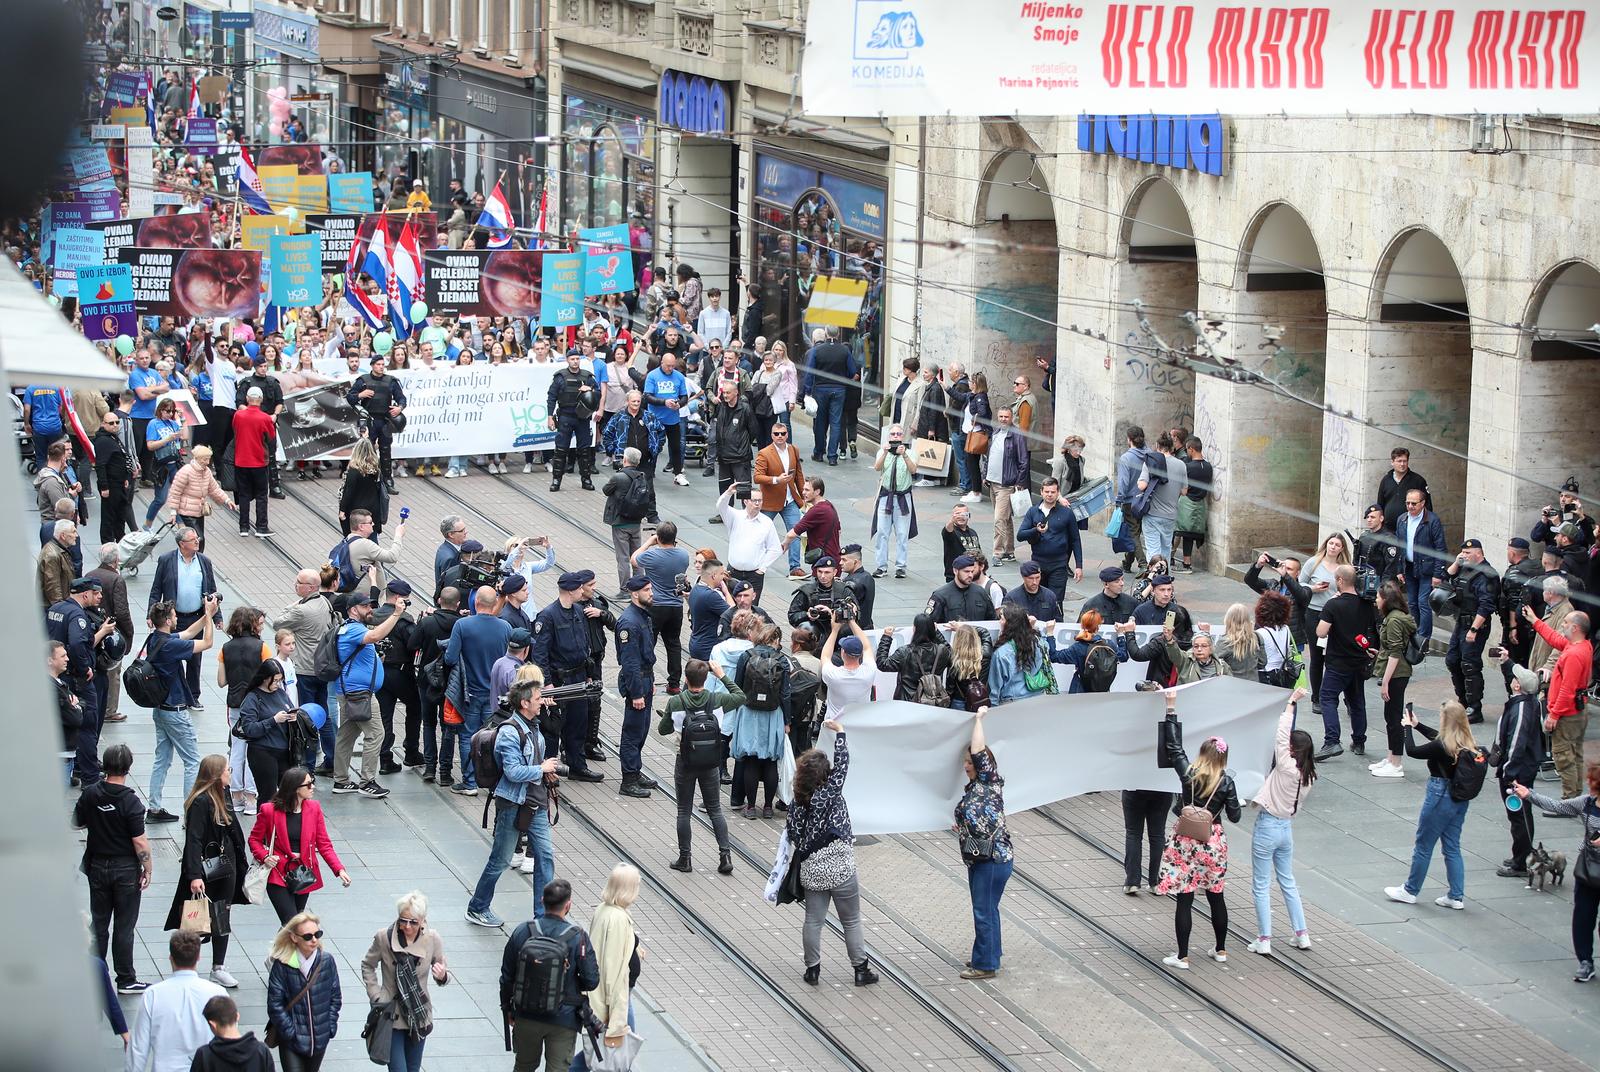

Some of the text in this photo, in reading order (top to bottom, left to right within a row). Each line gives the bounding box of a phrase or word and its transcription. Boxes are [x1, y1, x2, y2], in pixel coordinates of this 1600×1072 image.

[1021, 2, 1083, 21] Miljenko
[1034, 25, 1079, 45] Smoje
[1101, 4, 1330, 90] VELO MISTO
[1364, 8, 1587, 90] VELO MISTO
[852, 65, 925, 78] KOMEDIJA
[1031, 62, 1077, 76] redateljica
[999, 77, 1079, 90] Marina Pejnović
[661, 68, 725, 133] nama
[56, 211, 64, 219] 52
[65, 211, 82, 219] DANA
[105, 224, 133, 236] OVAKO
[324, 218, 355, 229] OVAKO
[66, 235, 94, 244] ZAŠTITIMO
[139, 253, 173, 266] OVAKO
[286, 252, 307, 261] LIVES
[446, 256, 479, 267] OVAKO
[80, 266, 127, 278] OVO JE IZBOR
[431, 268, 479, 279] IZGLEDAM
[133, 278, 171, 289] S DESET
[441, 280, 479, 291] S DESET
[438, 292, 479, 303] TJEDANA
[83, 307, 98, 316] OVO
[100, 305, 108, 315] JE
[109, 303, 133, 313] DIJETE
[416, 371, 492, 391] zaustavljaj
[408, 387, 530, 408] kucaje moga srca!
[439, 409, 462, 426] daj
[464, 407, 483, 422] mi
[510, 403, 548, 427] HO
[397, 428, 449, 448] ljubav...
